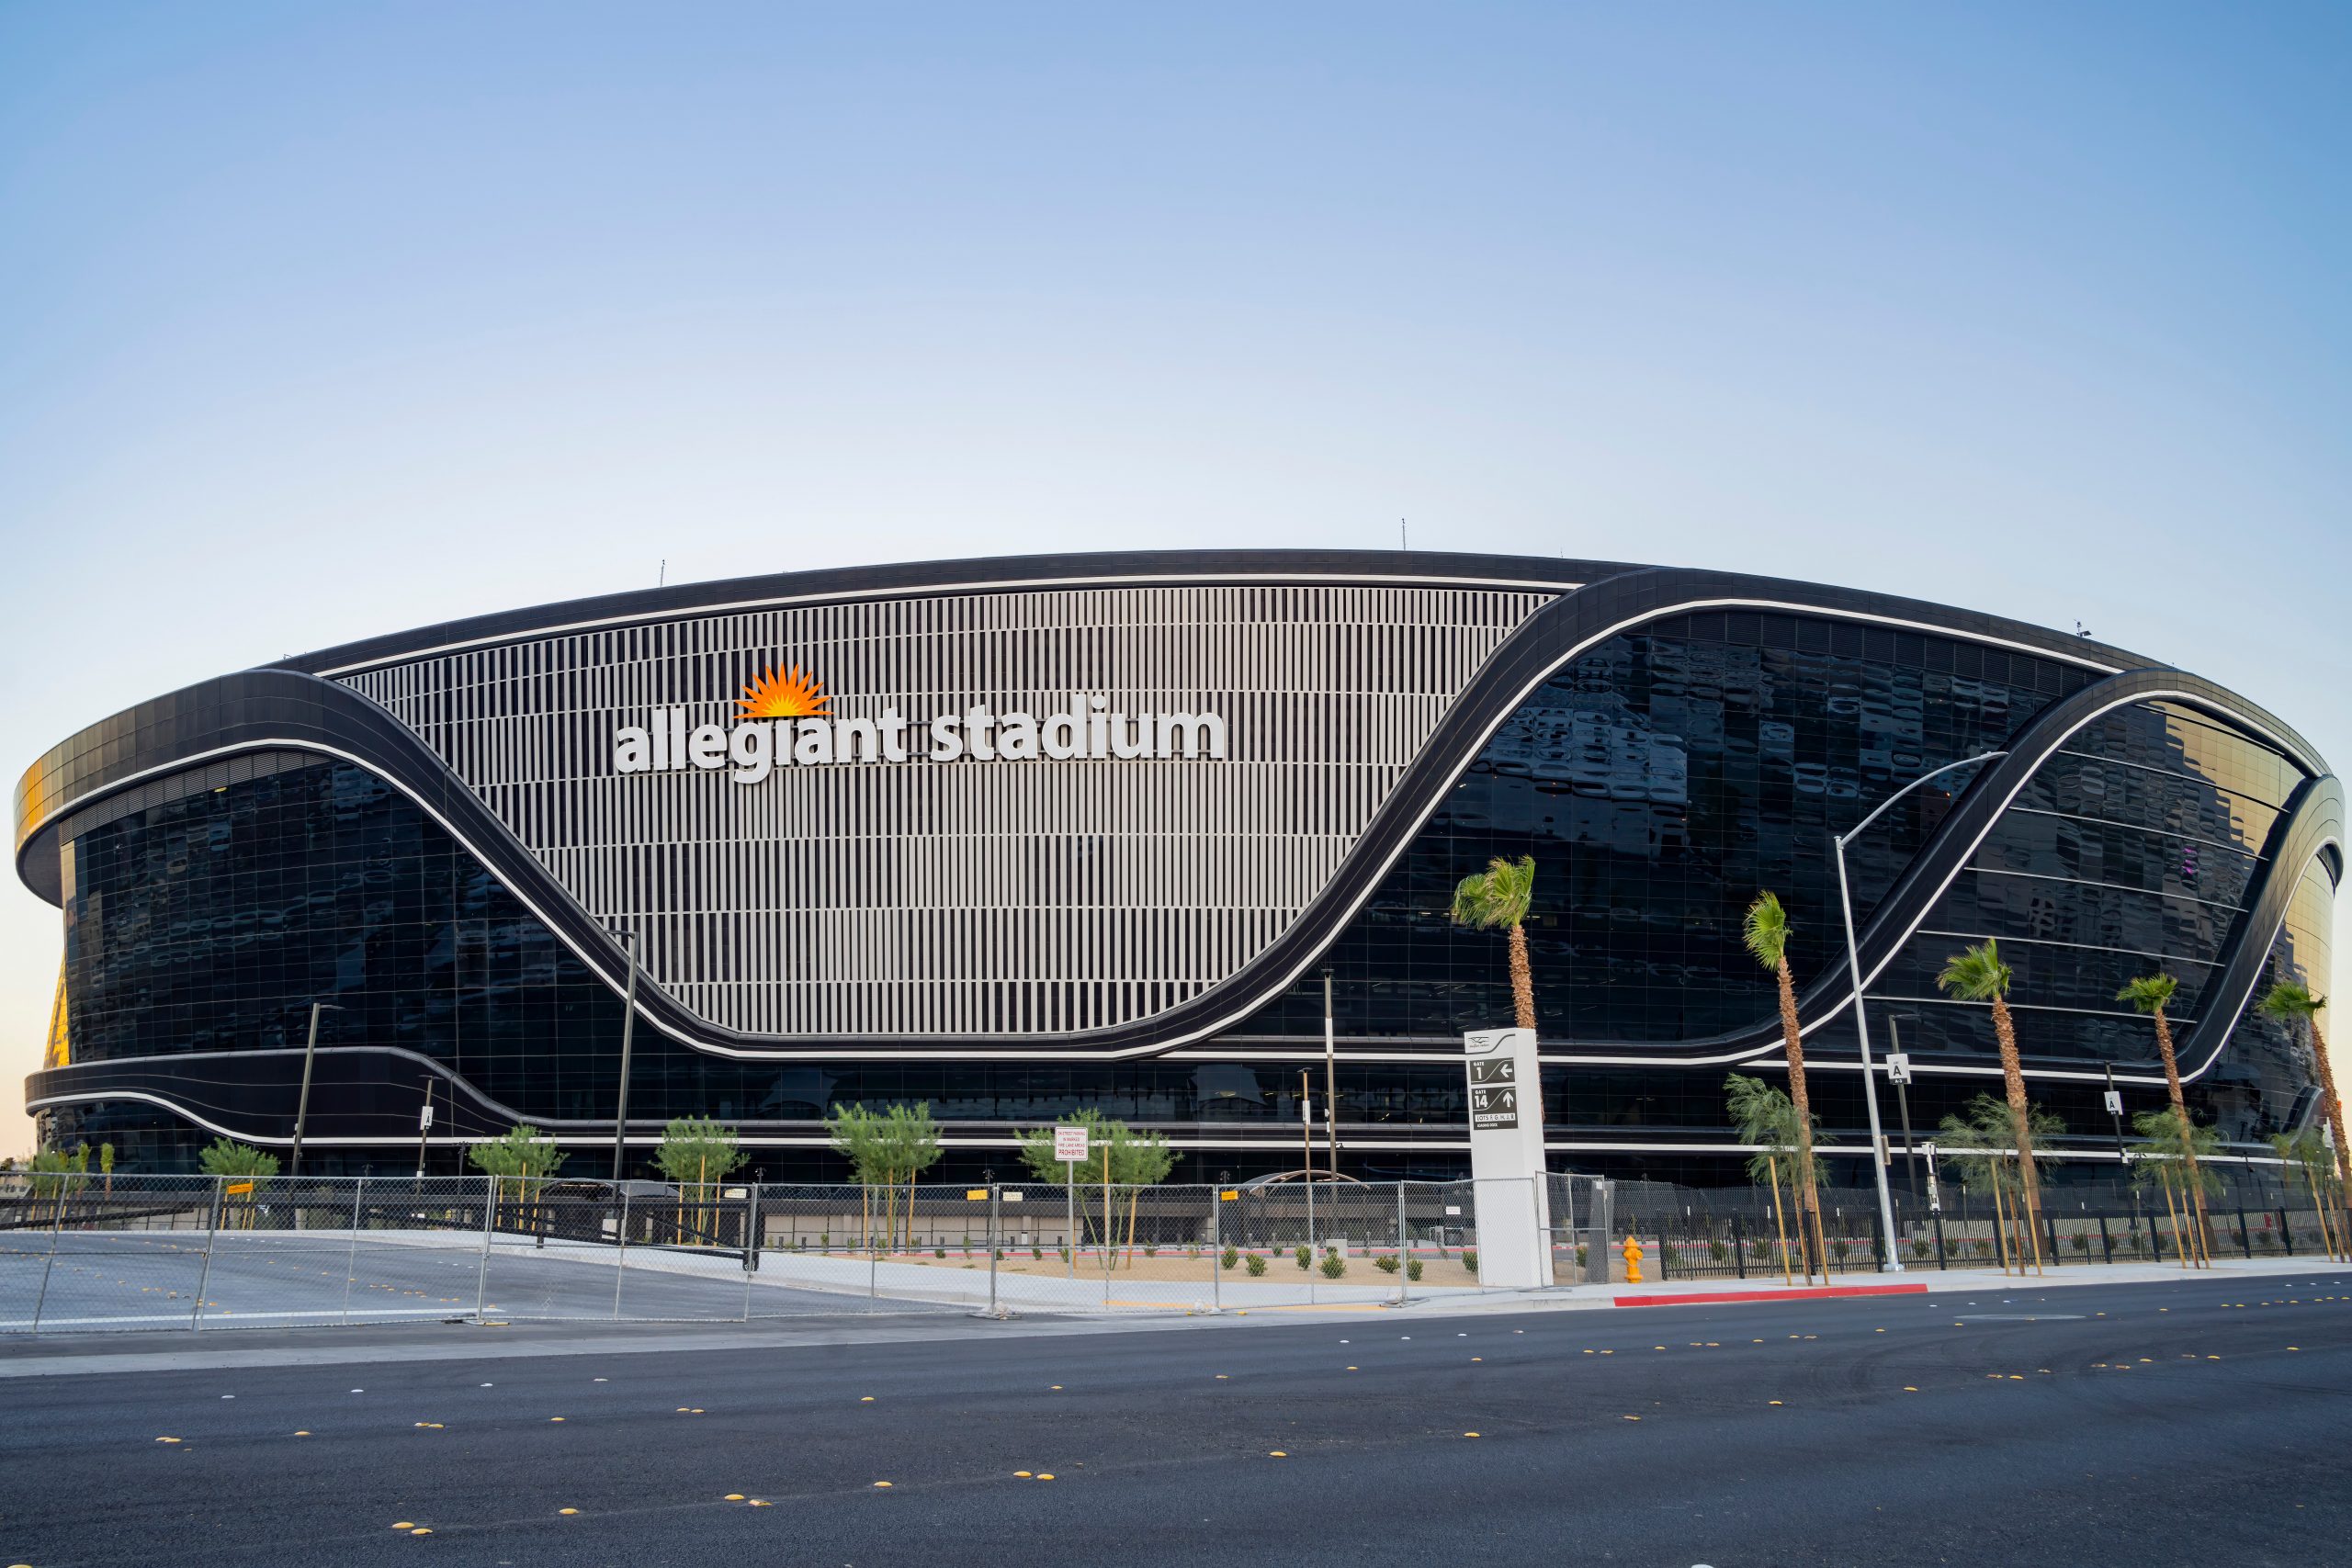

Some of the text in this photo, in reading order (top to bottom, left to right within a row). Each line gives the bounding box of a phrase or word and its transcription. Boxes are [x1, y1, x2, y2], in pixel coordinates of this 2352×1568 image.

[614, 694, 1225, 784] allegiant stadium
[1476, 1066, 1482, 1079] 1
[1893, 1065, 1901, 1076] A
[1474, 1095, 1488, 1108] 14
[2110, 1100, 2115, 1109] A
